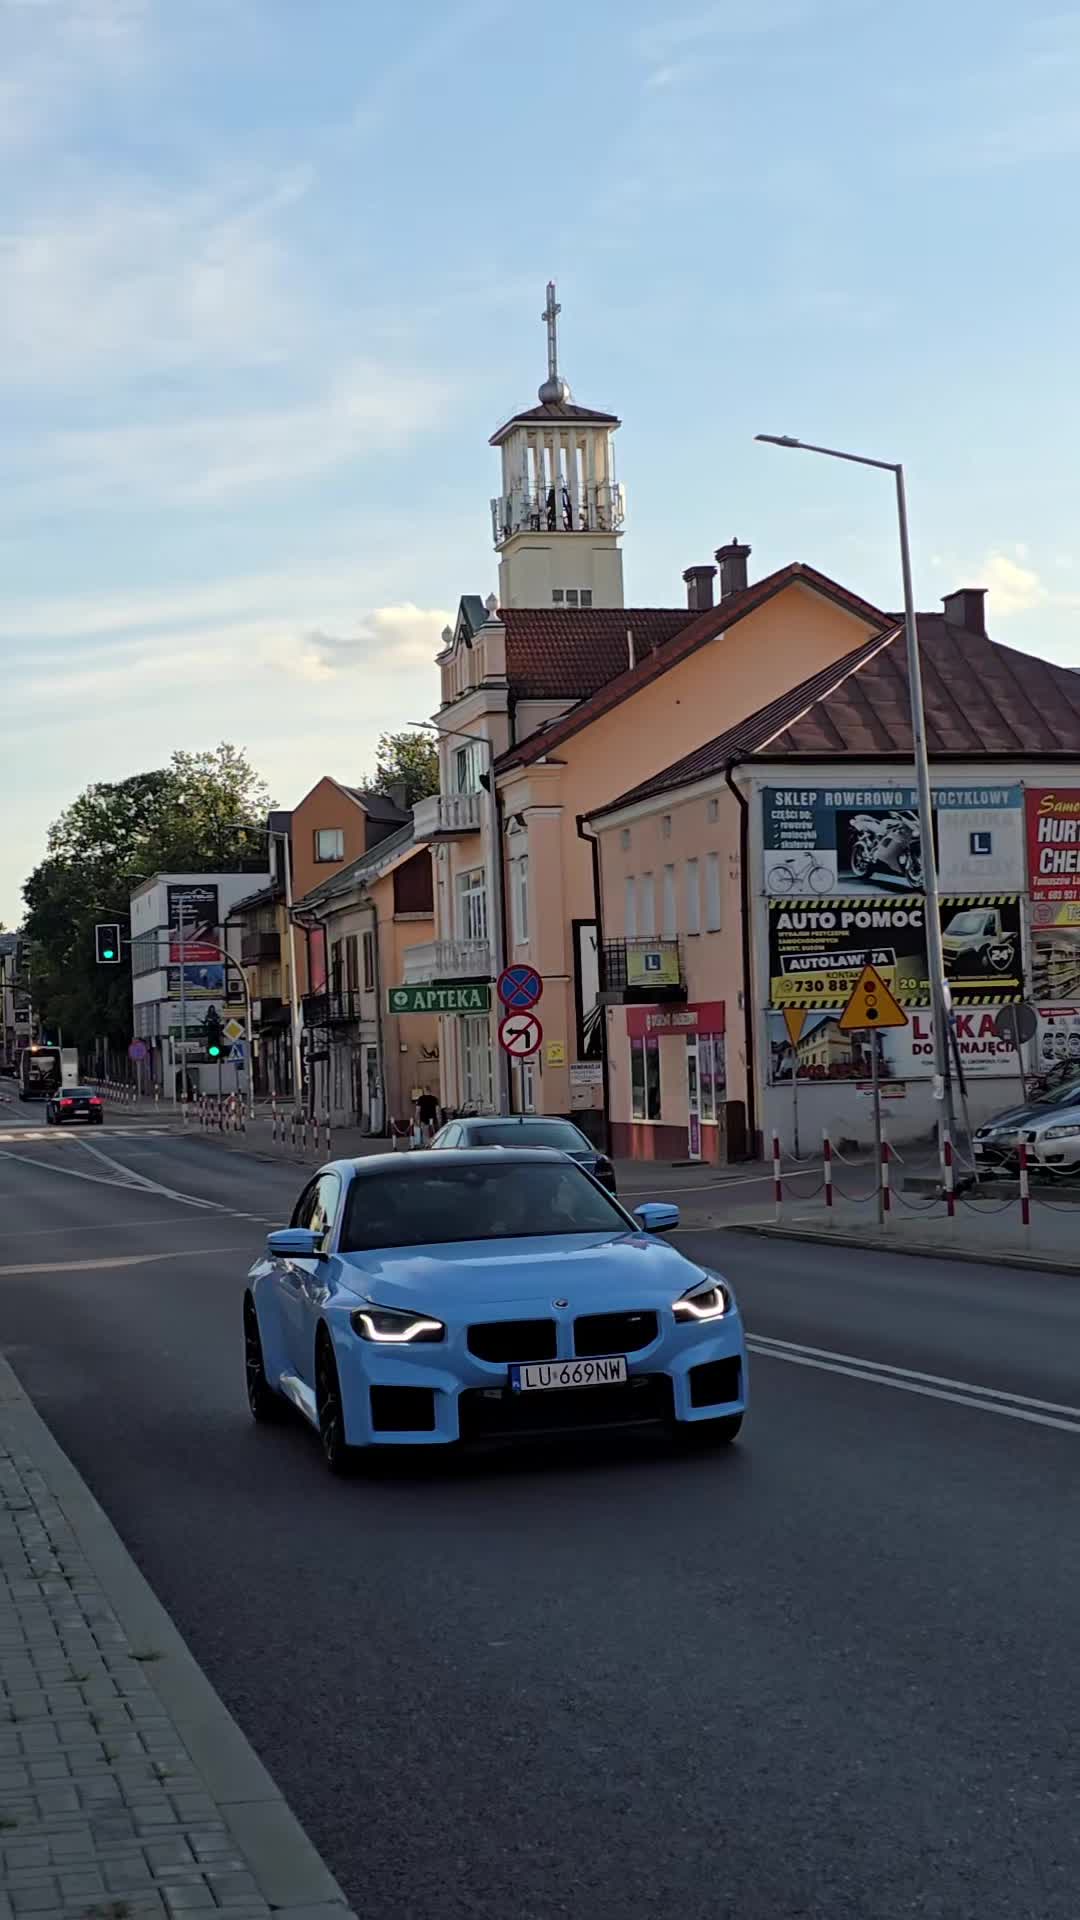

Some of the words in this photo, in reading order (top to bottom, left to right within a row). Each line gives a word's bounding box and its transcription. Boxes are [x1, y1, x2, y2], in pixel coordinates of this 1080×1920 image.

[775, 791, 817, 806] SKLEP
[824, 791, 904, 806] ROWEROWO
[910, 790, 1009, 806] MTOCYKLOWY
[1039, 847, 1080, 874] CHE
[776, 911, 837, 930] AUTO
[840, 910, 923, 929] POMOC
[788, 952, 889, 971] AUTOLAWTA
[794, 980, 824, 993] 730
[900, 979, 917, 990] 20
[413, 989, 482, 1010] APTEKA
[912, 1013, 1000, 1040] LKA
[912, 1043, 934, 1056] DO
[525, 1365, 551, 1388] LU
[559, 1359, 621, 1385] 669NW
